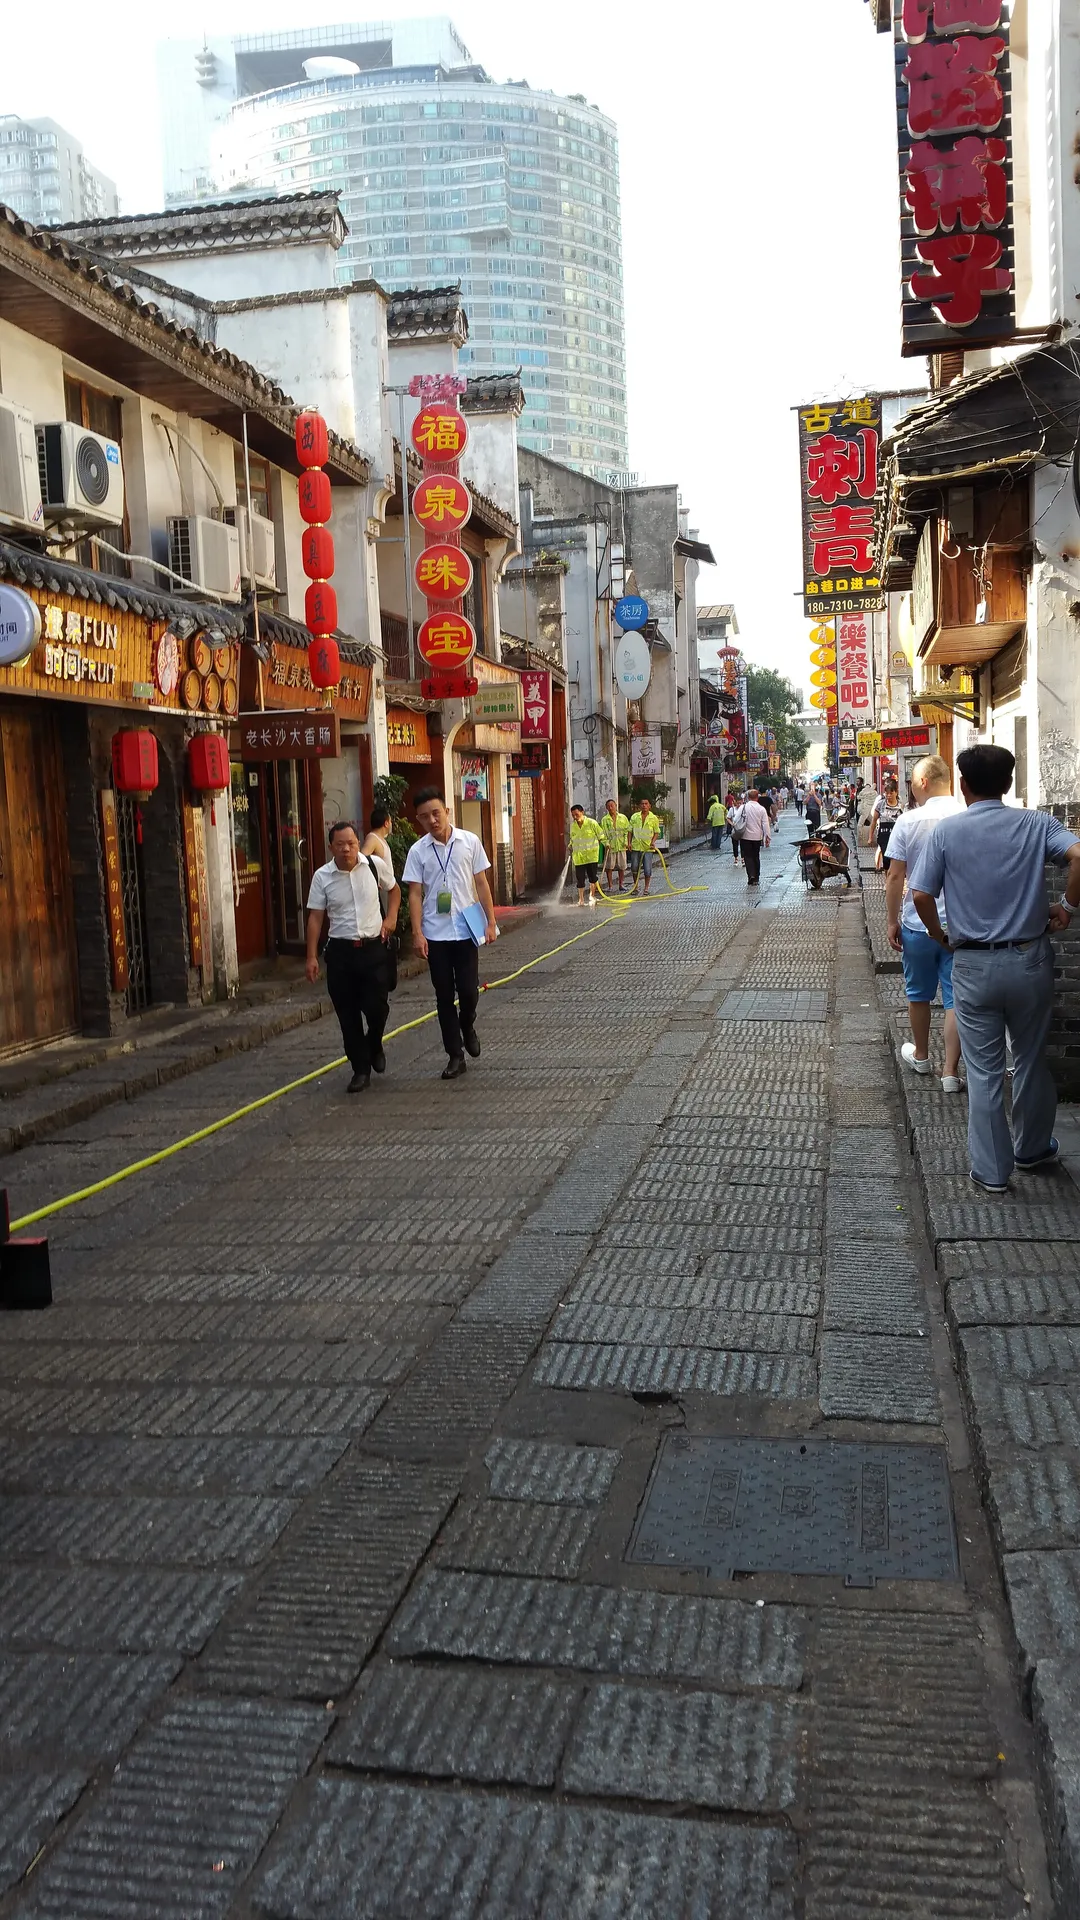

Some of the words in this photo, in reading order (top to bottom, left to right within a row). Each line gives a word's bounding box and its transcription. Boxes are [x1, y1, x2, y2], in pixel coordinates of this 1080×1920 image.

[800, 397, 880, 432] 古道
[606, 472, 638, 488] 网吧
[807, 428, 879, 576] 刺青
[415, 414, 472, 657] 福泉珠宝
[620, 603, 643, 616] 茶房
[524, 681, 547, 728] 美甲
[246, 727, 331, 749] 老长沙大香肠
[638, 757, 657, 769] Coffee
